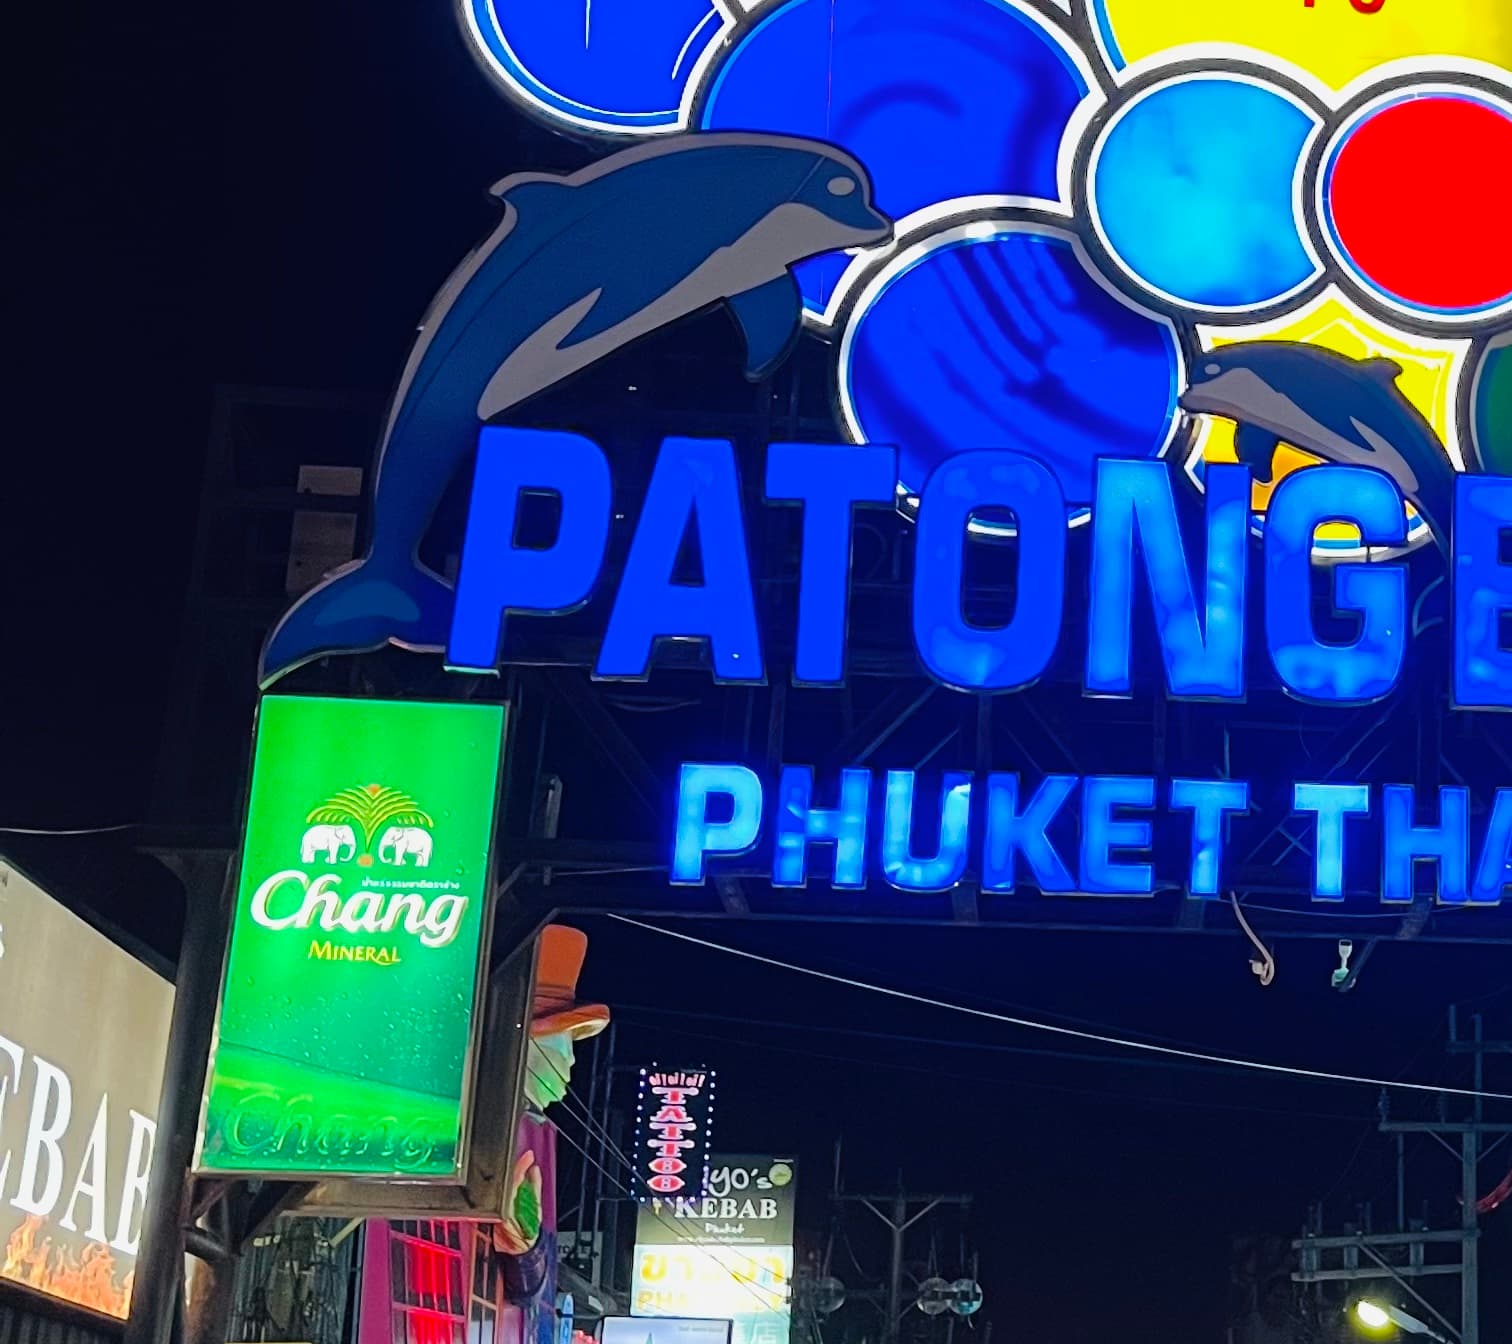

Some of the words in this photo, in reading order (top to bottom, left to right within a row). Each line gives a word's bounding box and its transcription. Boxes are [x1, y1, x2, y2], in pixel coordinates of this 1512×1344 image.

[444, 425, 1410, 705] PATONG
[669, 760, 1250, 898] PHUKET
[250, 869, 469, 949] Chang
[308, 940, 402, 966] MINERAL
[674, 1197, 778, 1220] KEBAB
